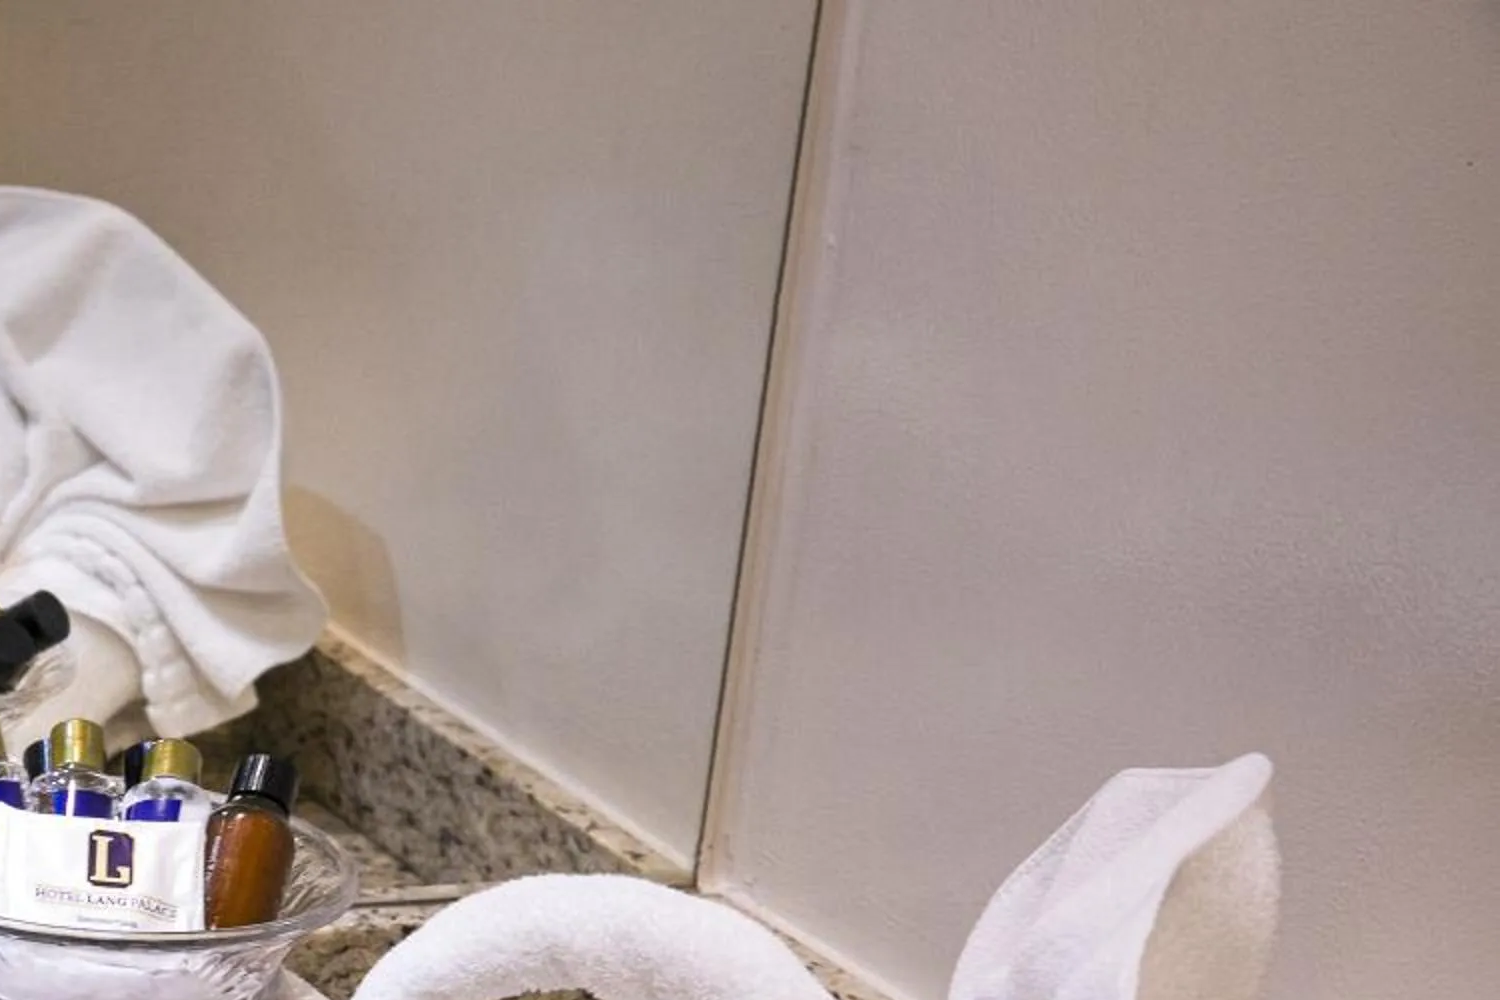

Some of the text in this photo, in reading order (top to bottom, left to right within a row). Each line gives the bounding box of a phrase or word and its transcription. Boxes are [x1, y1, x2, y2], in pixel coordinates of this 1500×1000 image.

[89, 834, 131, 884] L
[34, 887, 82, 901] HOTEL
[87, 893, 127, 906] LANG
